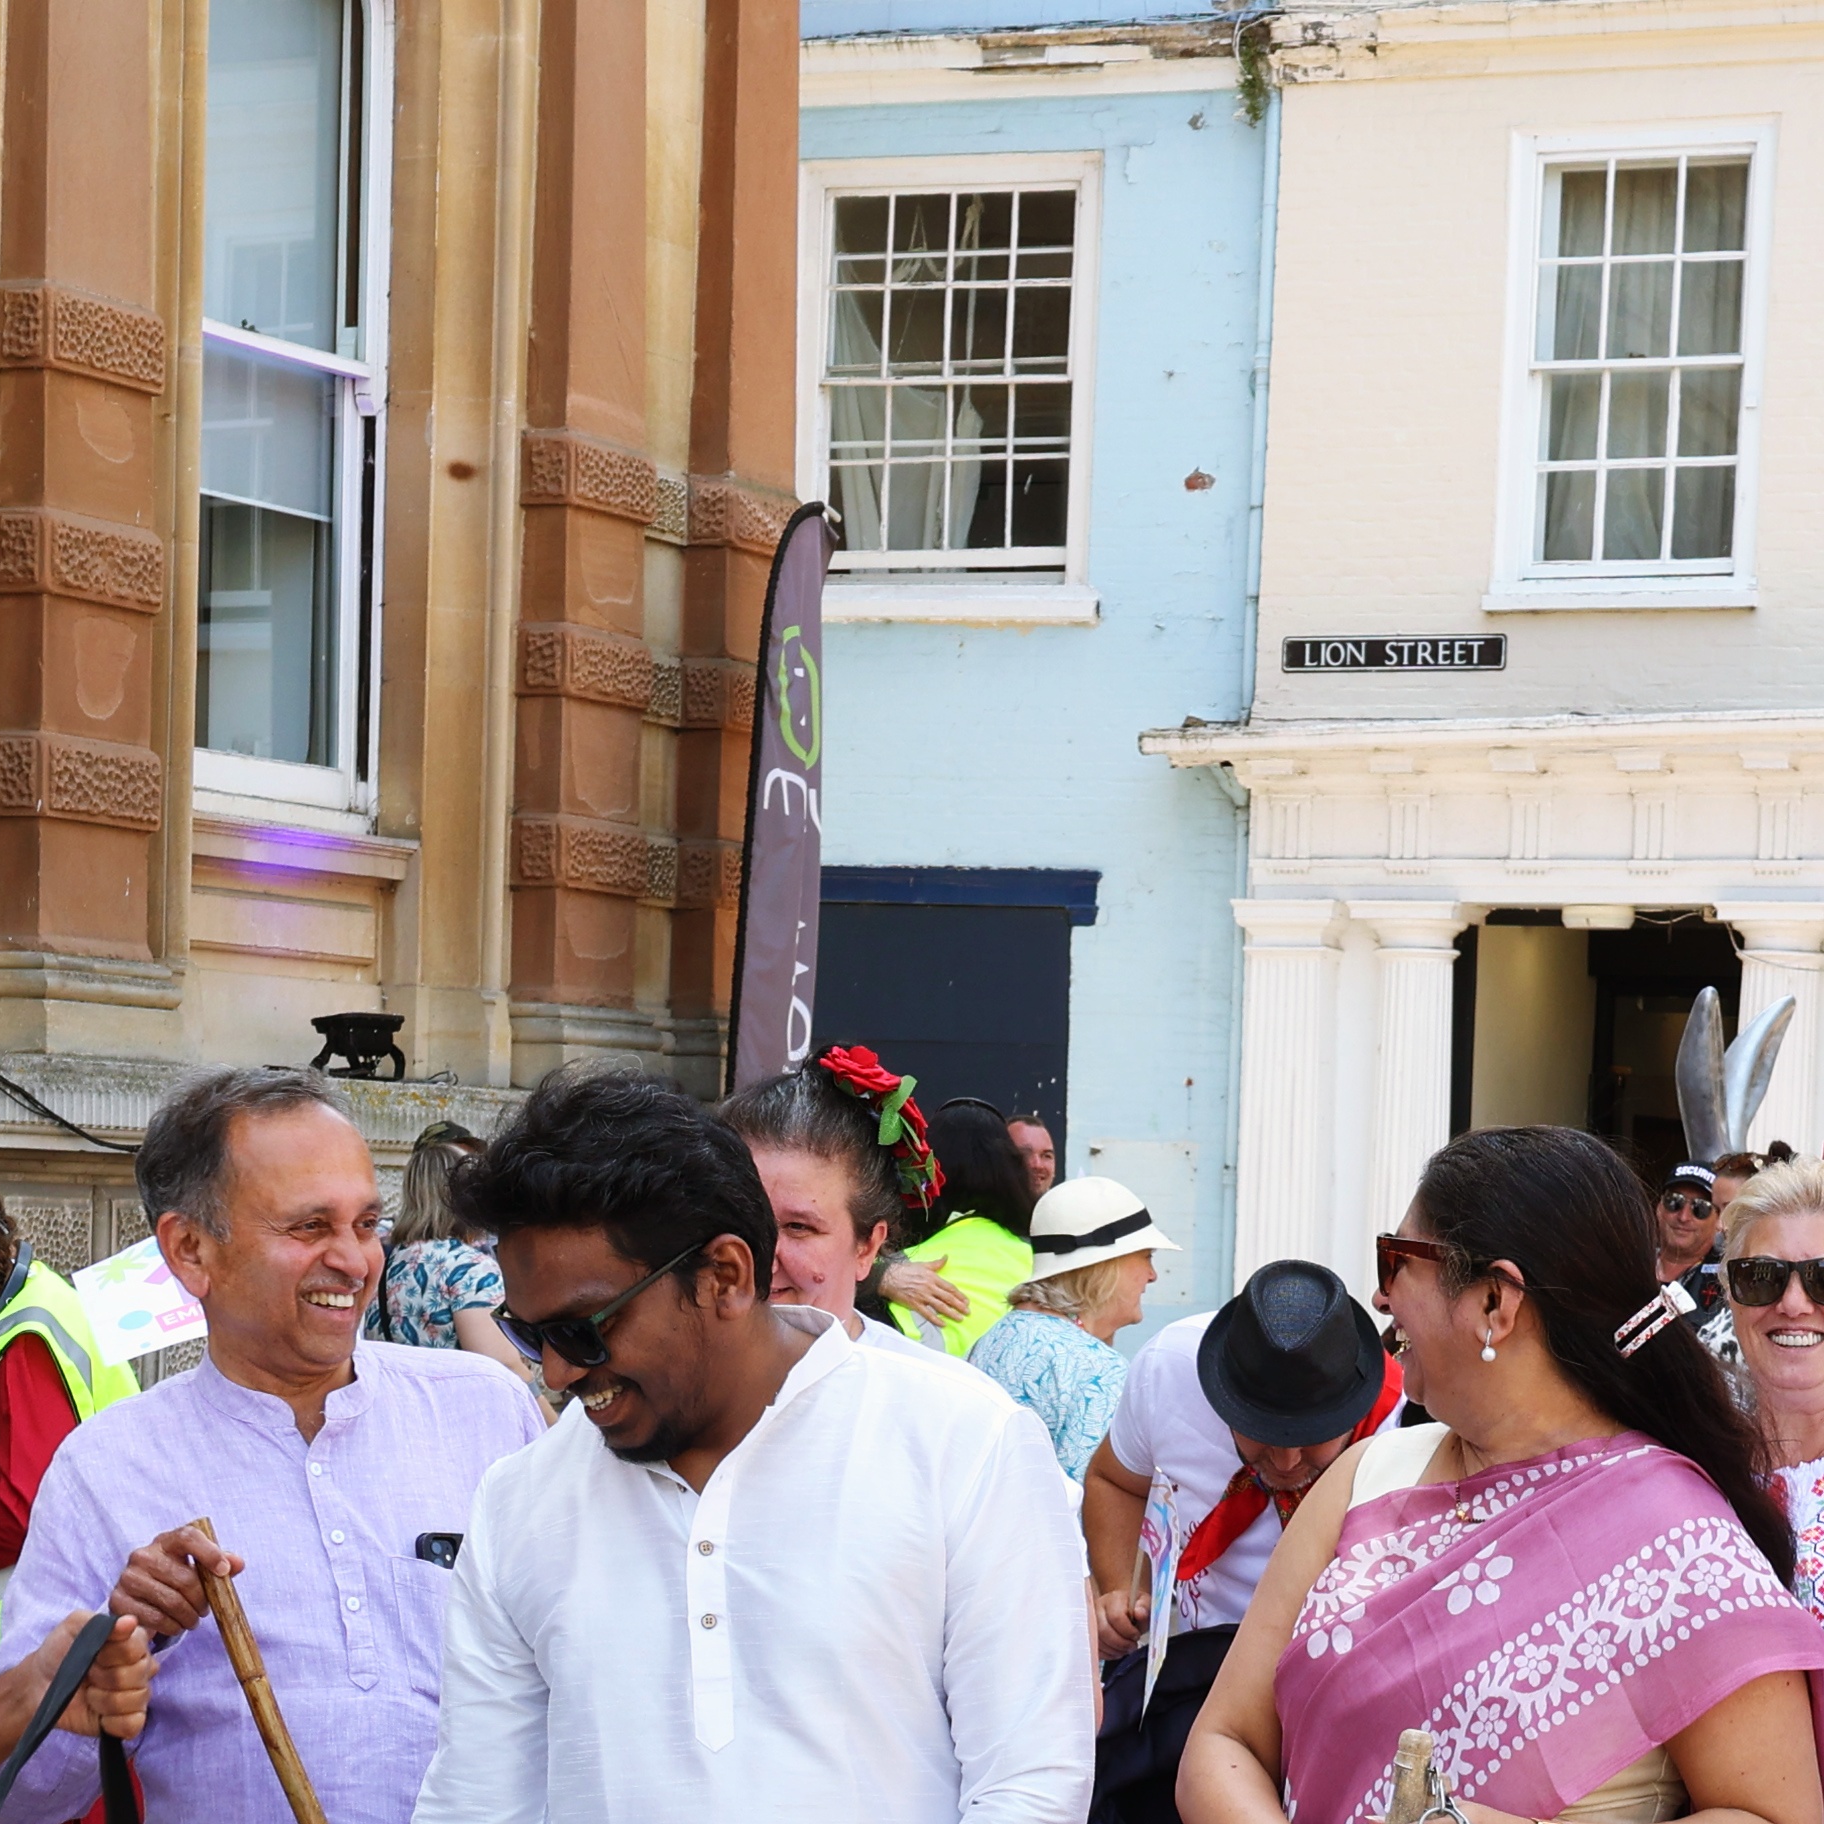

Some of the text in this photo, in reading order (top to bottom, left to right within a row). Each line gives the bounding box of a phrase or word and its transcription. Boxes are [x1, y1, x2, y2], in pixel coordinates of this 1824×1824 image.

[1304, 640, 1485, 667] LION STREET
[1674, 1165, 1717, 1184] SECURIT
[161, 1303, 206, 1327] EM
